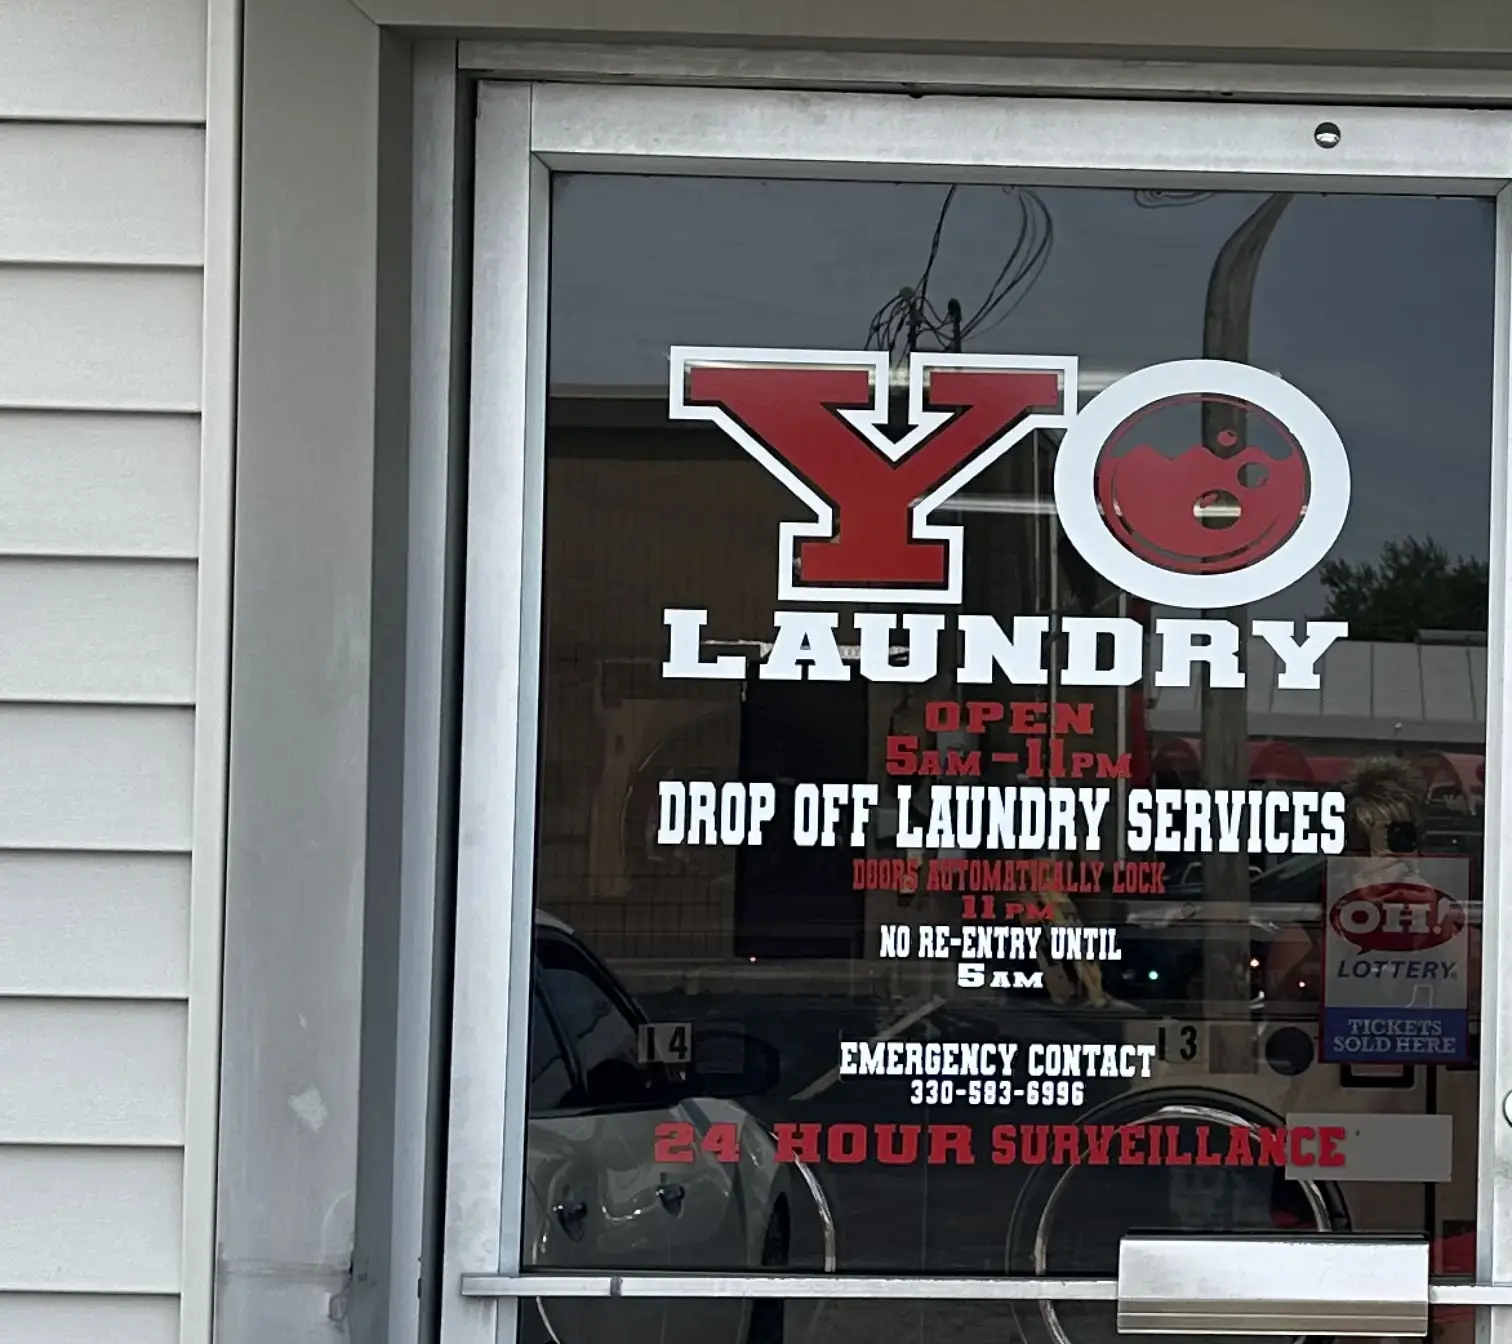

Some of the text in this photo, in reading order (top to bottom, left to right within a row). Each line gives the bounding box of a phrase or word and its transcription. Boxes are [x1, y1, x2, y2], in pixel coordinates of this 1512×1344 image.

[669, 346, 1352, 609] YO
[662, 608, 1349, 690] LAUNDRY
[925, 701, 1094, 735] OPEN
[657, 780, 1347, 854] DROP OFF LAUNDRY SERVICES
[853, 858, 1167, 895] DOORS AUTOMATICALLY LOCK
[1339, 897, 1452, 935] OH!
[879, 924, 1122, 961] NO RE-ENTRY UNTIL
[1333, 1036, 1456, 1054] SOLD HERE
[1348, 1018, 1442, 1036] TICKETS
[839, 1041, 1156, 1078] EMERGENCY CONTACT
[910, 1080, 1084, 1106] 330-583-6996
[654, 1122, 1346, 1167] 24 HOUR SURVEILLANCE
